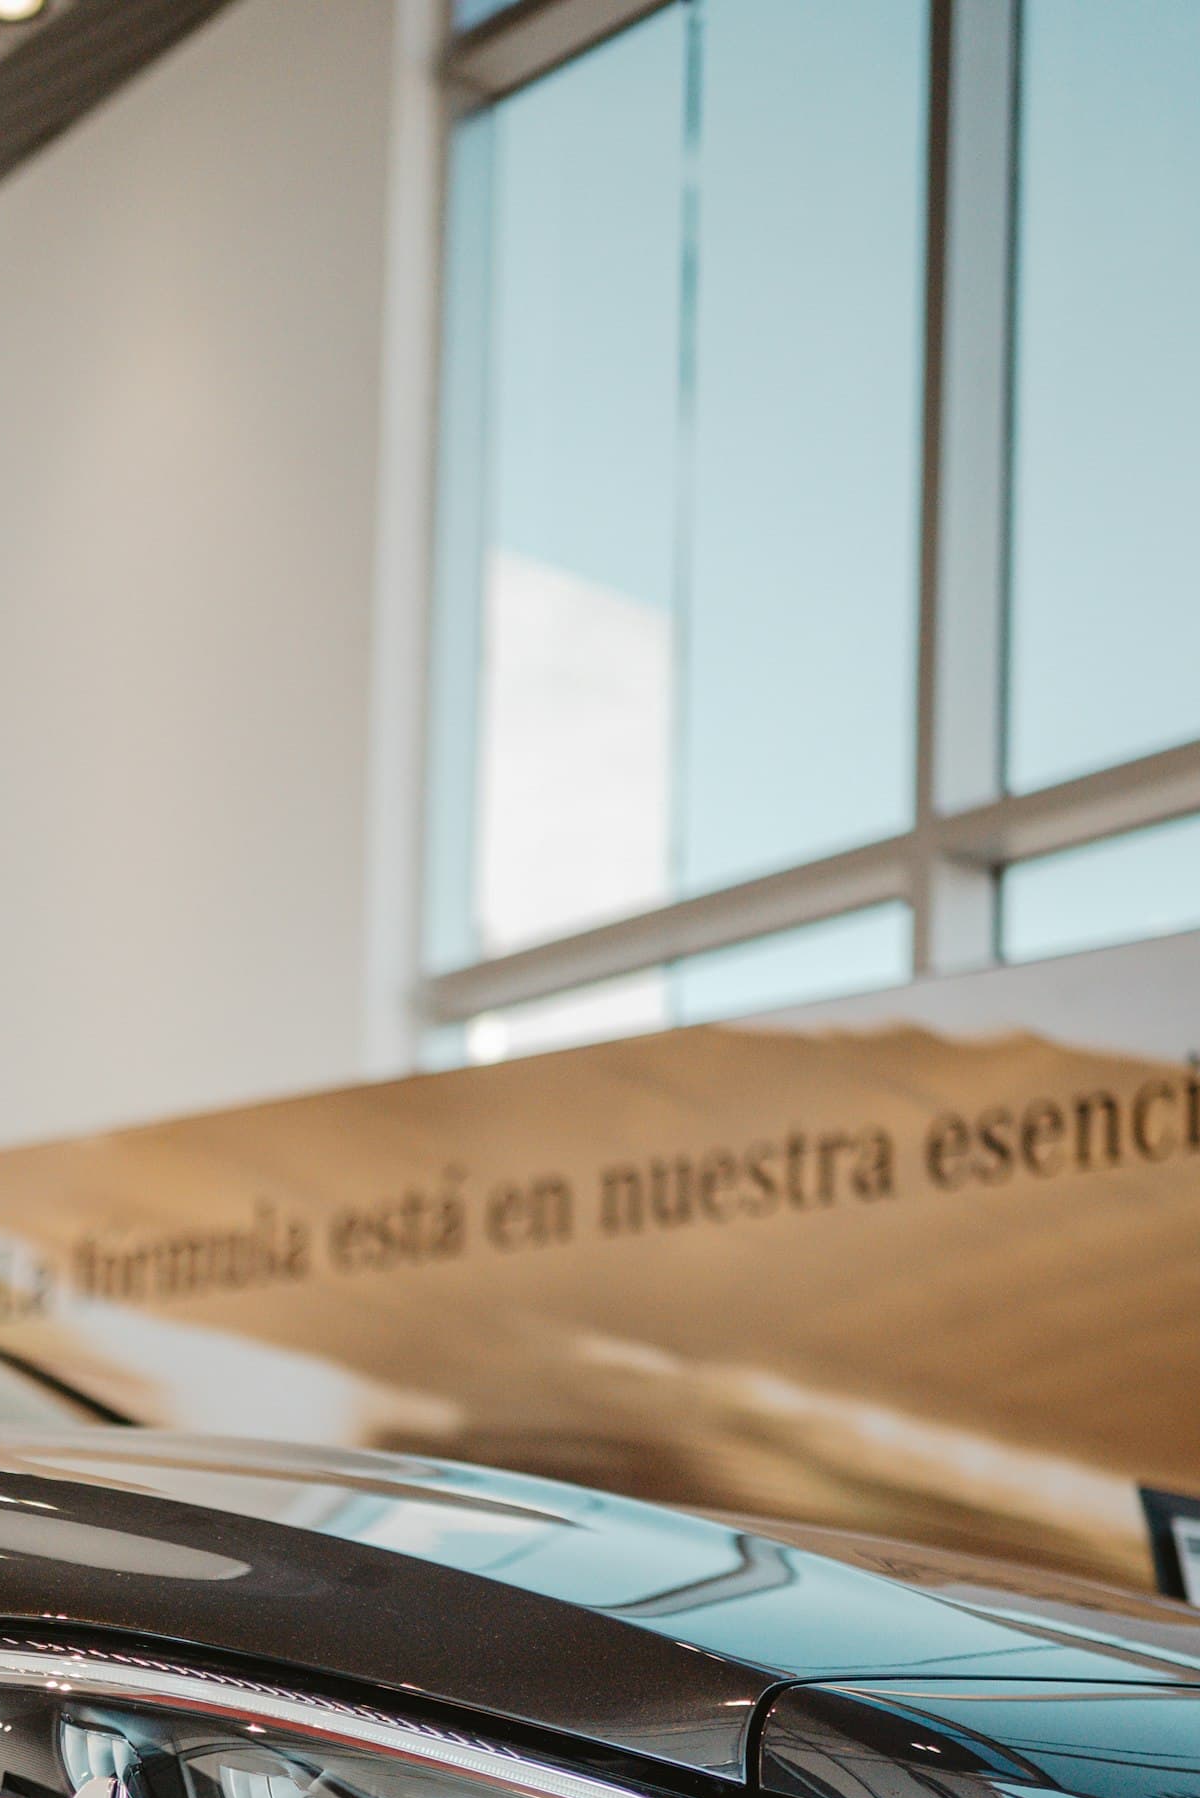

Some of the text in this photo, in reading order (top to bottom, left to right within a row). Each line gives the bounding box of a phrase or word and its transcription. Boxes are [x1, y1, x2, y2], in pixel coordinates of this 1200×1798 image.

[326, 1164, 468, 1272] está
[484, 1172, 575, 1254] en
[597, 1121, 896, 1238] nuestra
